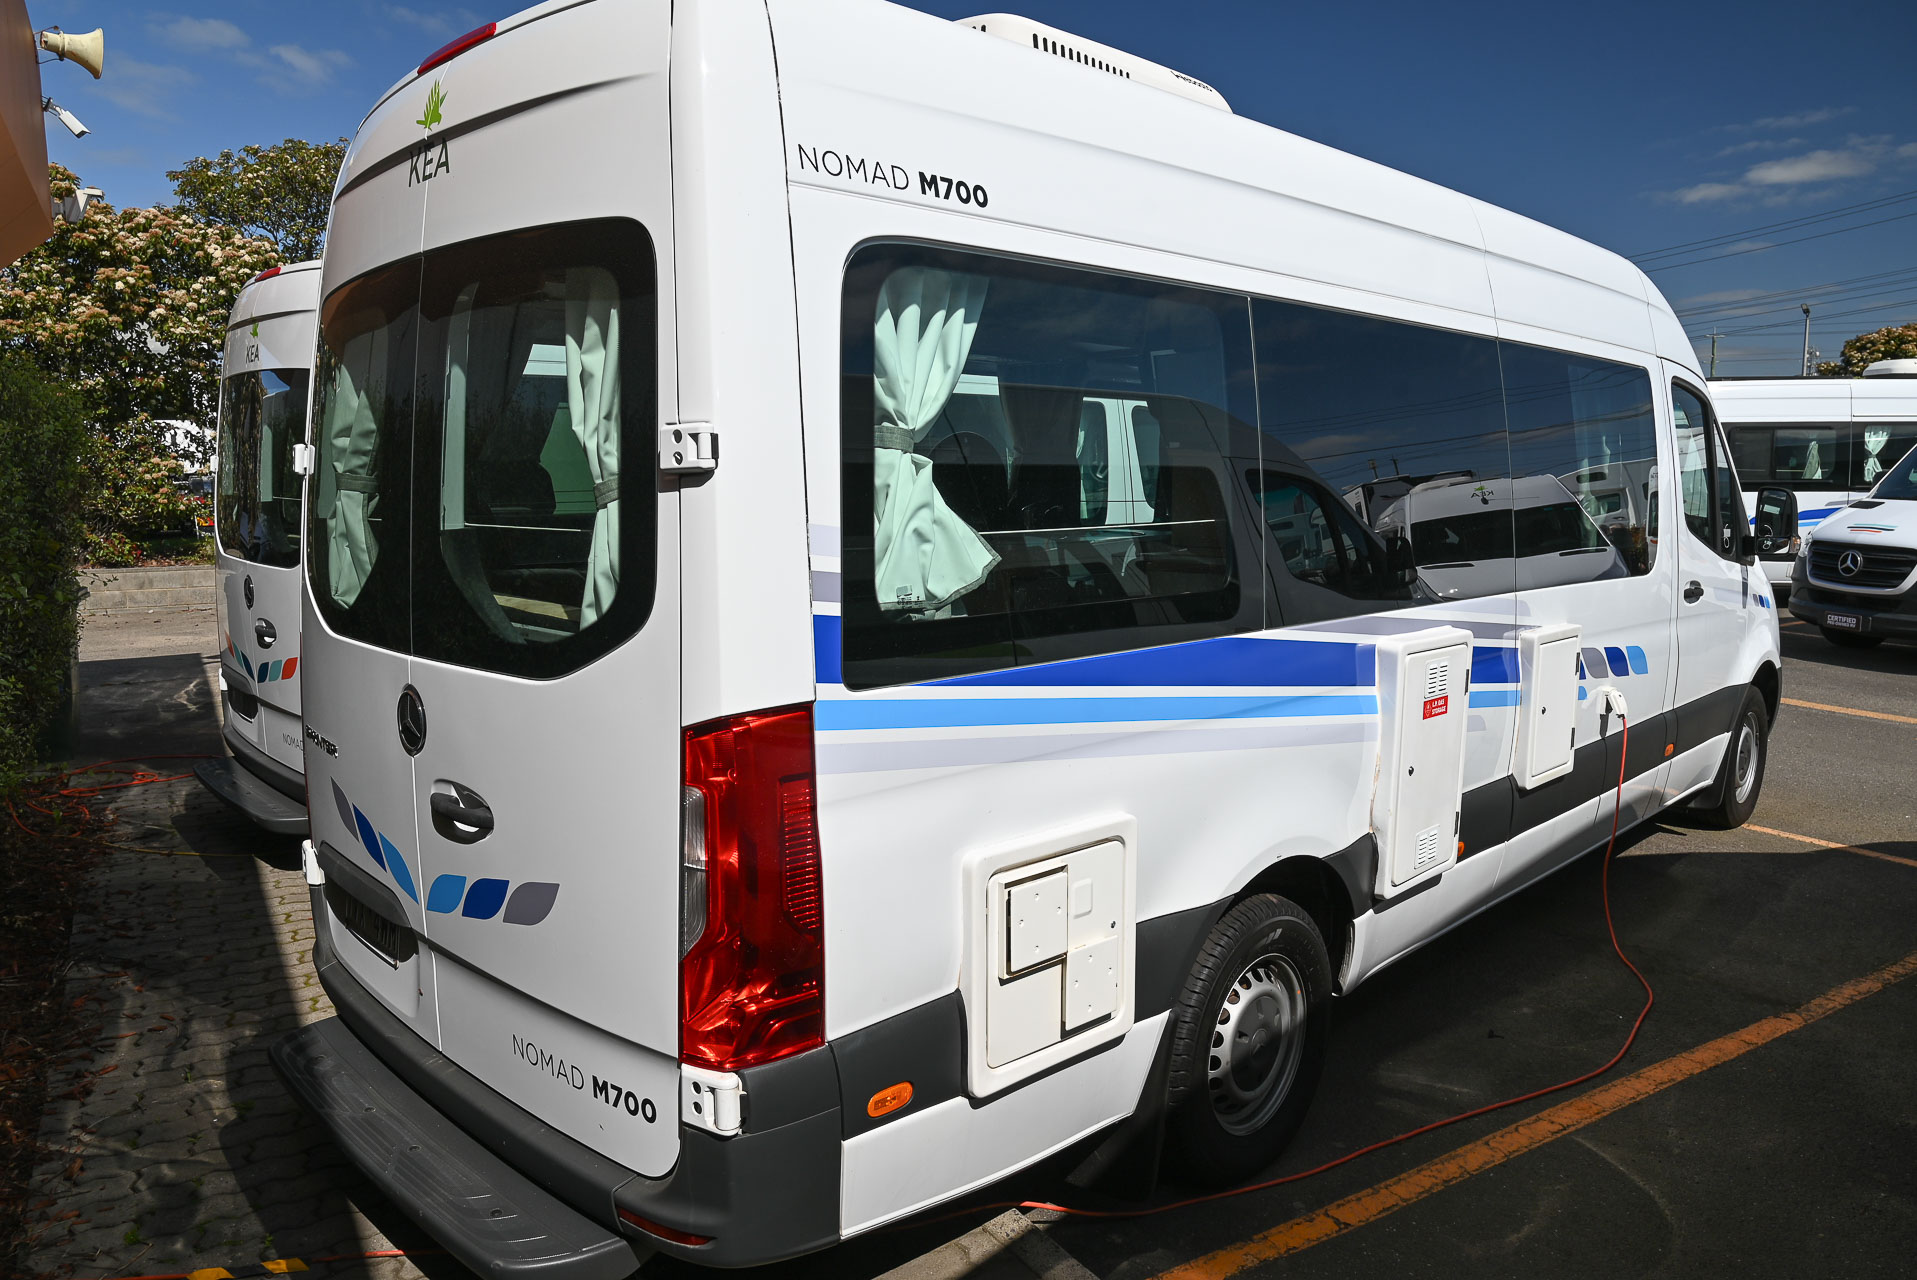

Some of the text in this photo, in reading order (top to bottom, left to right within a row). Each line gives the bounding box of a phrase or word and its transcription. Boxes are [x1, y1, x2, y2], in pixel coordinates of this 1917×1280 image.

[409, 137, 449, 187] KEA
[798, 144, 988, 208] NOMAD M700
[246, 344, 259, 363] KEA
[1827, 614, 1857, 624] CERTIFIED
[512, 1034, 657, 1124] NOMAD M700
